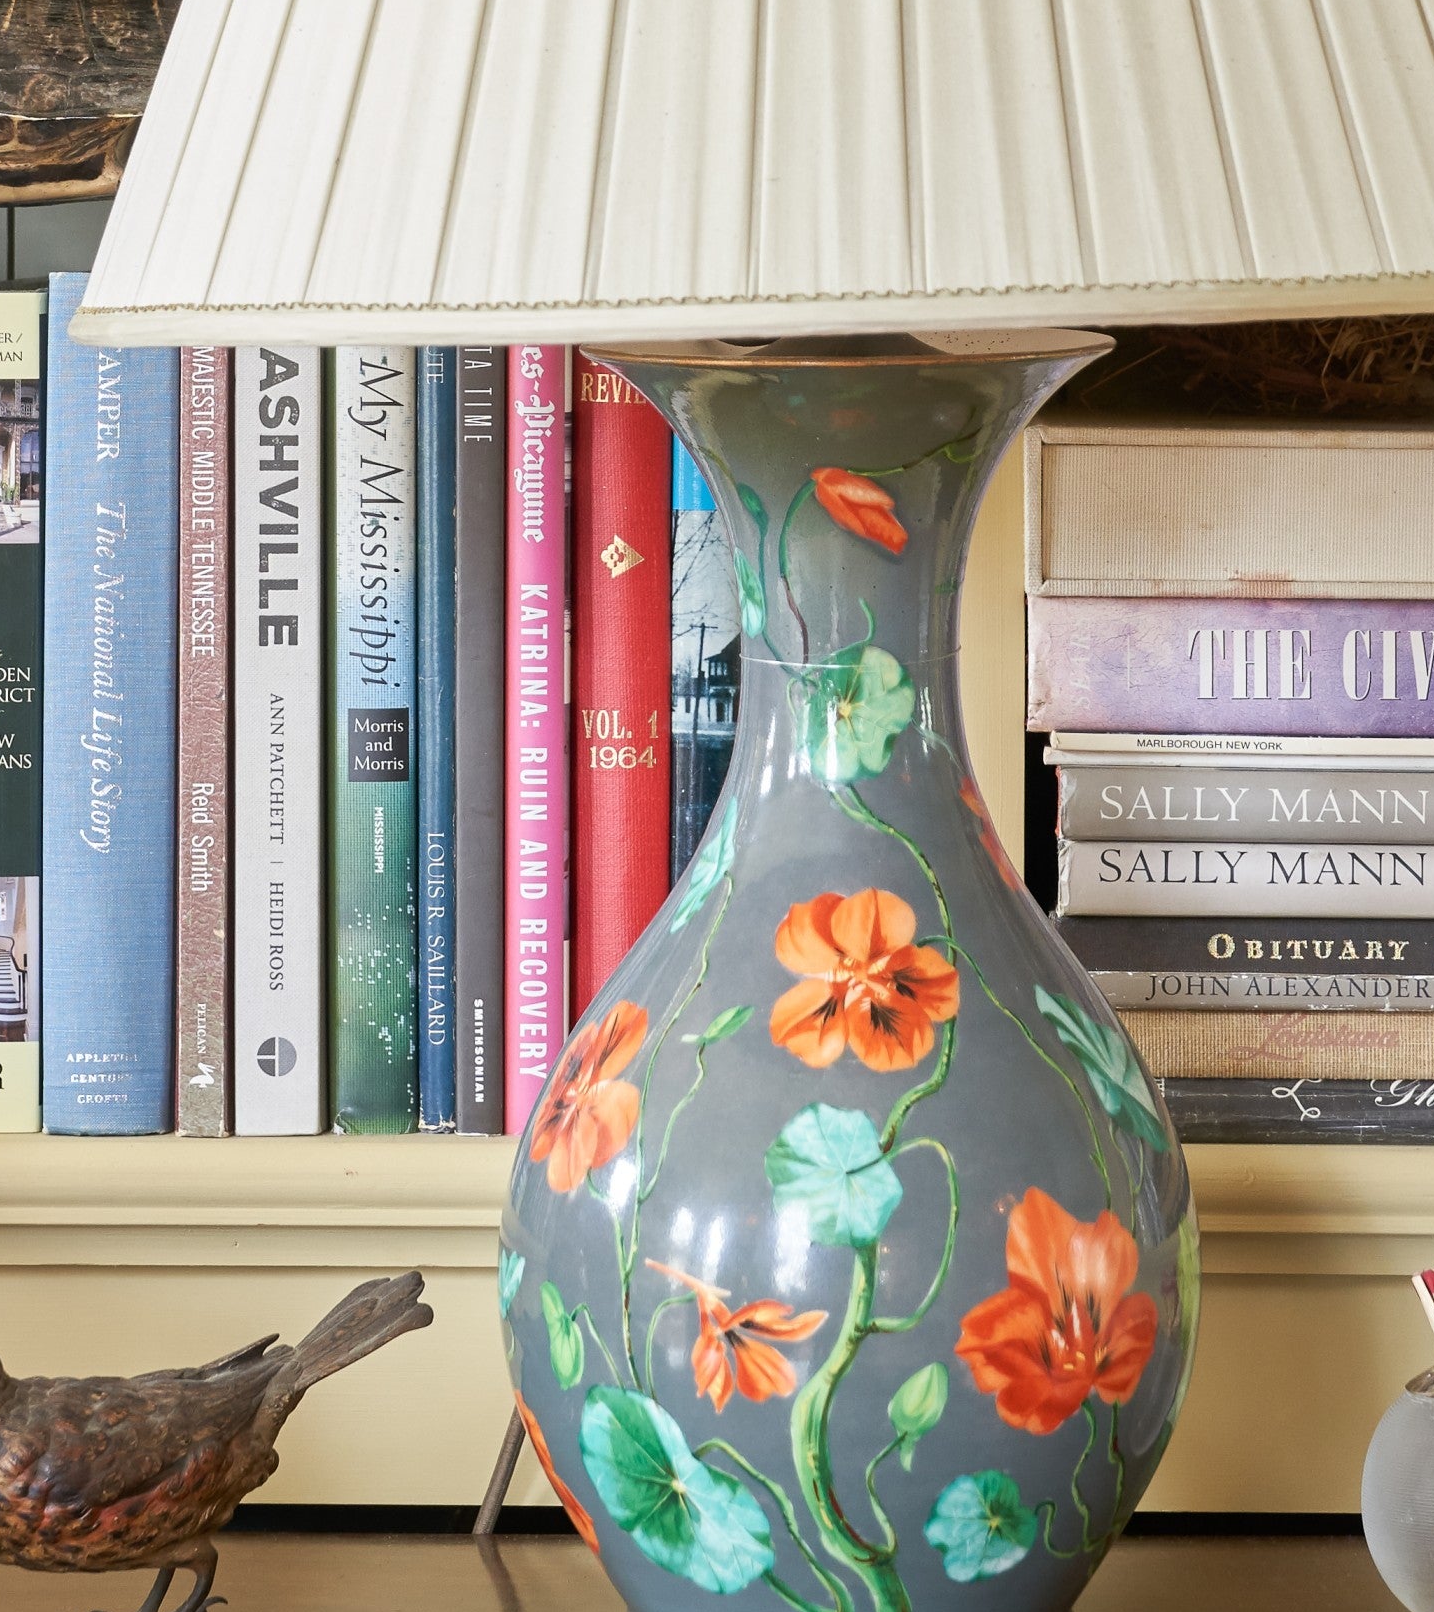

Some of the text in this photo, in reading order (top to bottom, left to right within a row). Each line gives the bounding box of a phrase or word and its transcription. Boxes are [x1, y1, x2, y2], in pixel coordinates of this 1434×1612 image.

[1190, 630, 1312, 701] THE
[354, 719, 404, 734] Morris
[582, 710, 658, 739] VOL. 1
[365, 739, 393, 752] and
[589, 747, 655, 769] 1964
[353, 755, 405, 772] Morris
[1098, 787, 1246, 825] SALLY
[1268, 787, 1427, 824] MANN
[1098, 851, 1246, 888] SALLY
[1268, 851, 1427, 888] MANN
[1208, 933, 1410, 962] OBITUARY
[1144, 972, 1432, 1001] JOHN ALEXANDER
